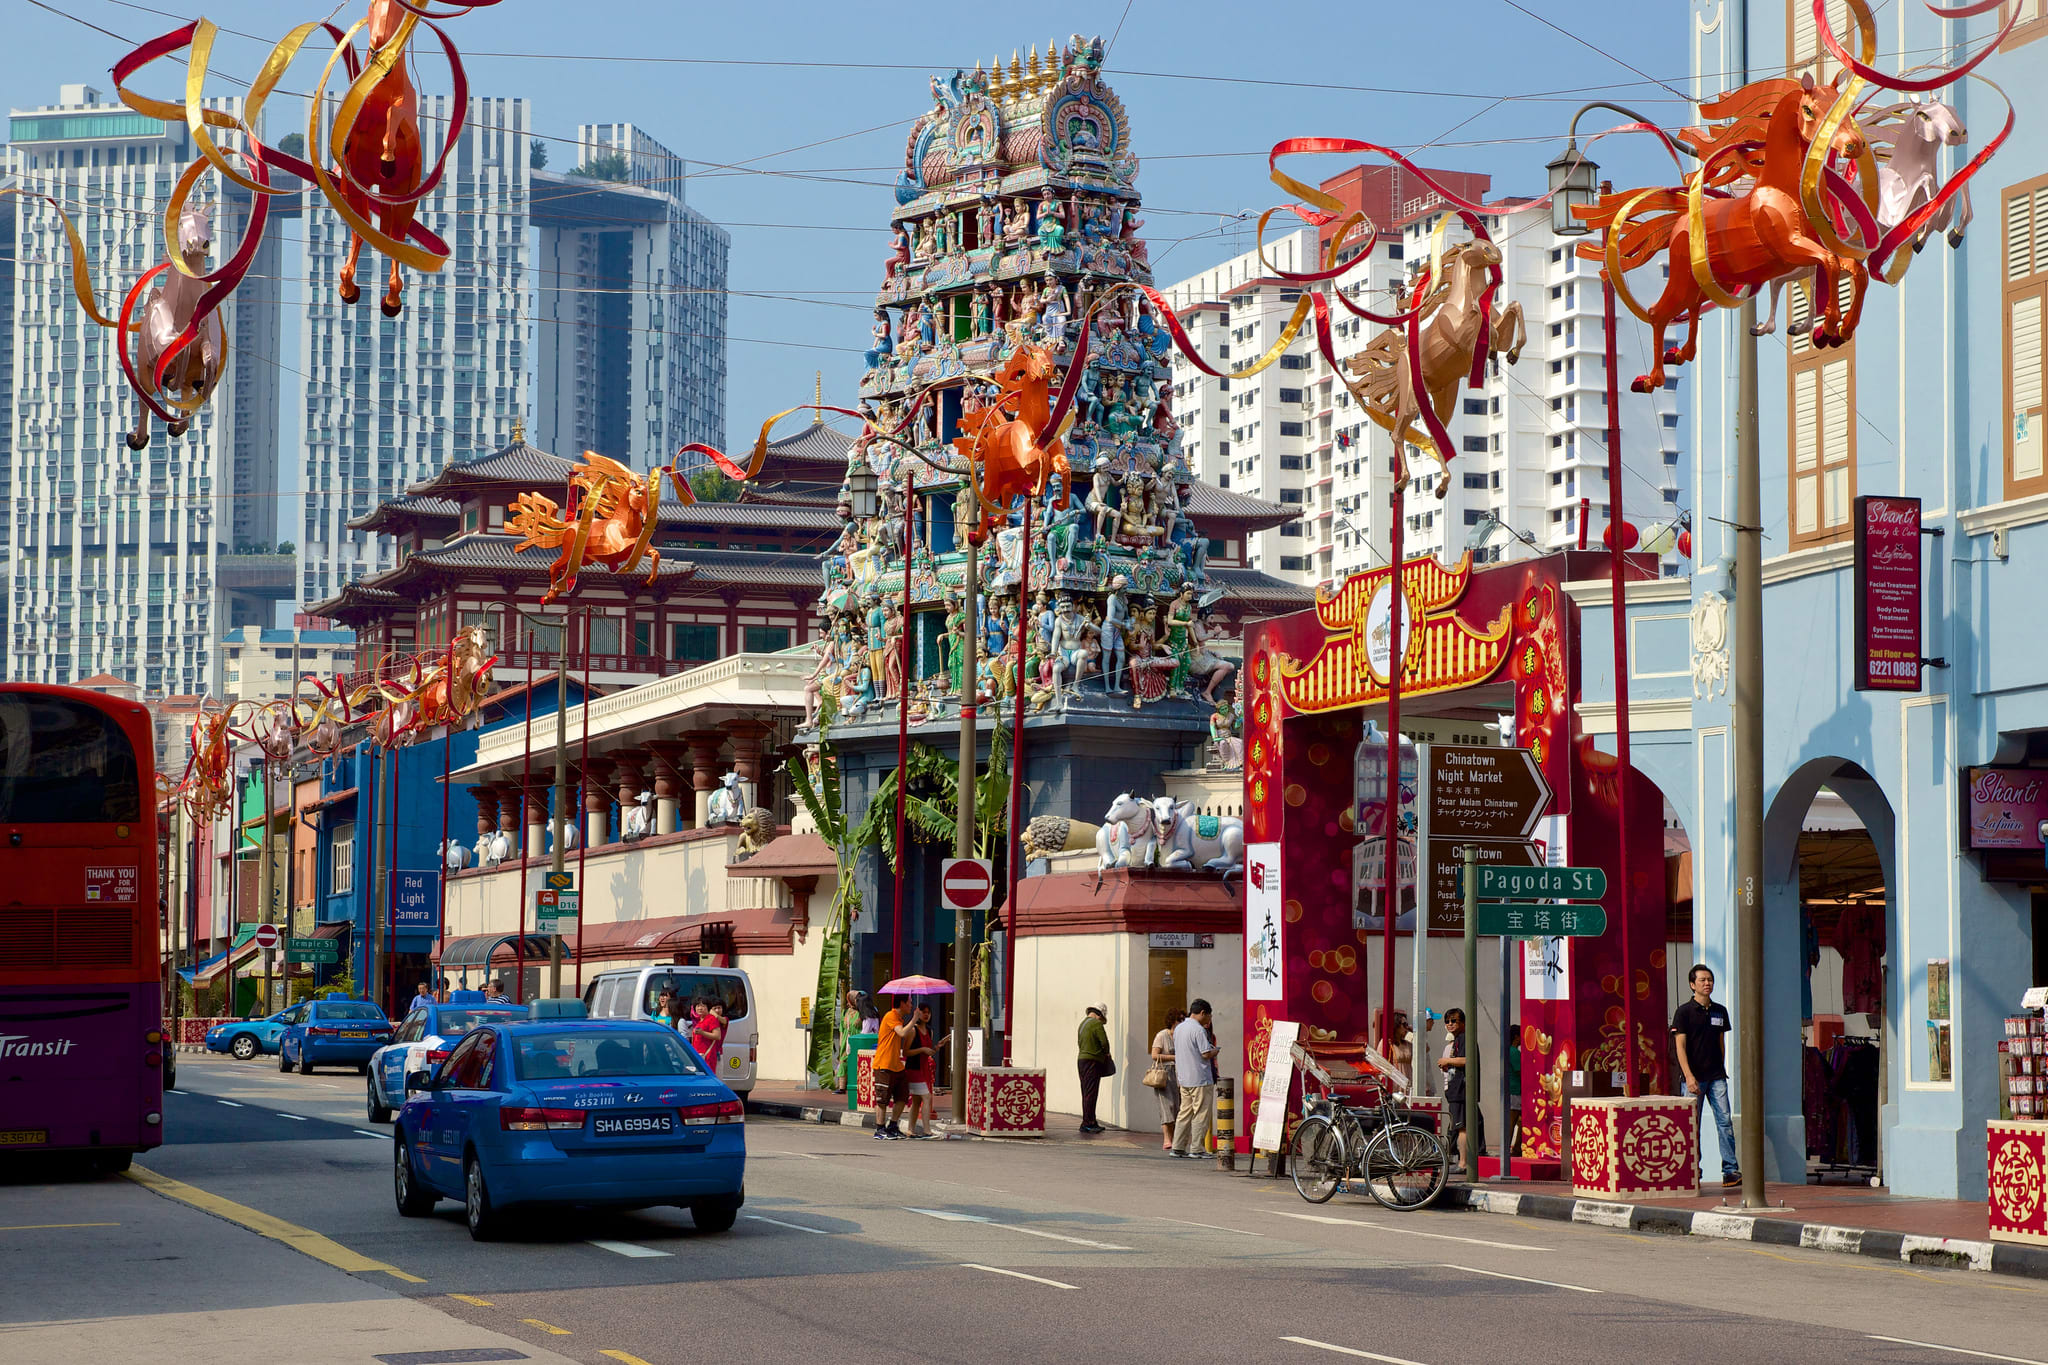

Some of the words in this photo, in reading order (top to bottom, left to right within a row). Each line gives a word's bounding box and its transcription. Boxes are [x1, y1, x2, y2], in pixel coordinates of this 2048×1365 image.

[1868, 501, 1918, 524] Shanti
[1867, 525, 1889, 539] Beauty
[1892, 527, 1899, 536] &
[1902, 527, 1917, 537] Care
[1876, 606, 1892, 614] Body
[1873, 626, 1883, 634] Eye
[1869, 649, 1883, 658] 2nd
[1884, 650, 1901, 658] Floor
[1869, 661, 1891, 676] 6221
[1445, 752, 1496, 766] Chinatown
[1437, 768, 1464, 783] Night
[1469, 770, 1503, 783] Market
[1975, 772, 2043, 805] Shanti
[1437, 797, 1456, 806] Pasar
[1459, 798, 1481, 807] Malam
[1484, 798, 1518, 808] Chinatown
[1459, 820, 1492, 829] マーケット
[1452, 846, 1502, 860] Chtown
[87, 869, 115, 879] THANK
[118, 869, 135, 878] YOU
[404, 877, 423, 888] Red
[1484, 869, 1562, 893] Pagoda
[1572, 872, 1593, 891] St
[401, 892, 425, 907] Light
[1437, 890, 1456, 899] Pusat
[560, 901, 577, 909] D16
[395, 908, 429, 919] Camera
[1507, 910, 1577, 930] 宝塔街
[292, 940, 321, 948] Temple
[324, 940, 333, 948] St
[574, 1098, 598, 1107] 6552
